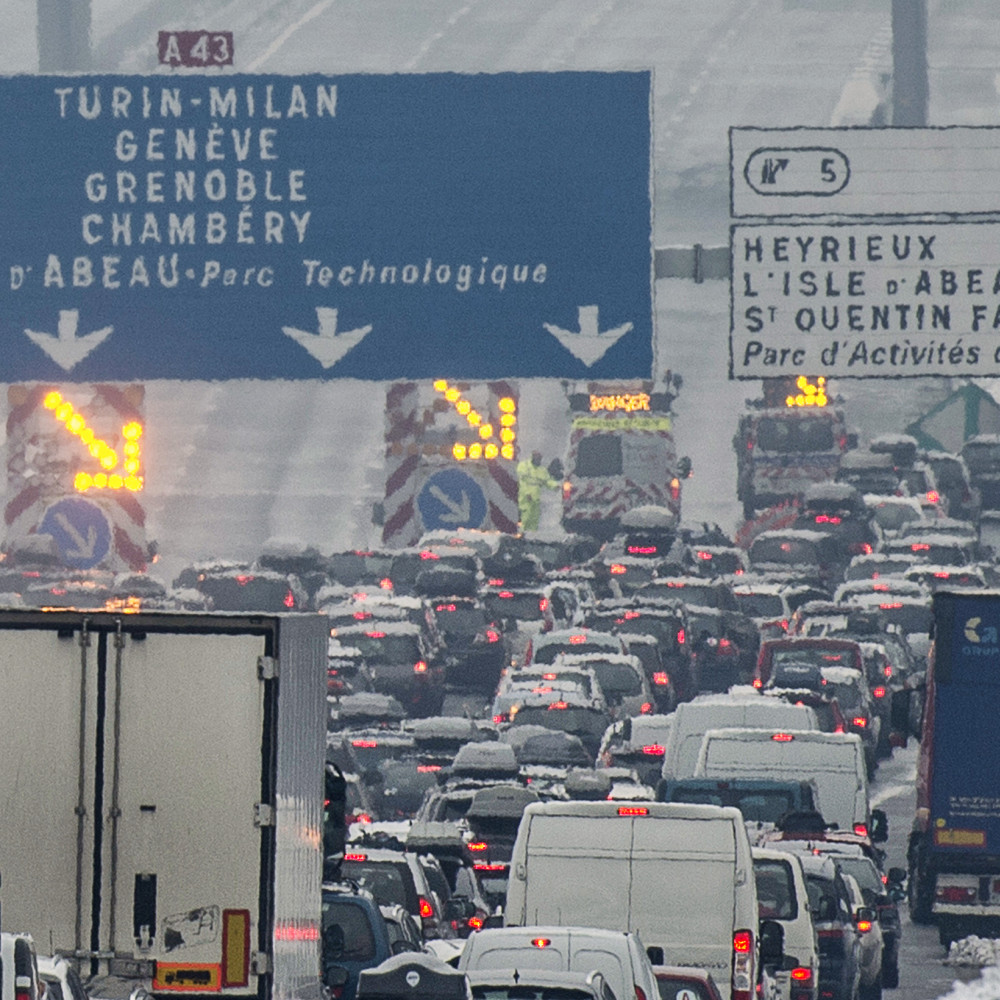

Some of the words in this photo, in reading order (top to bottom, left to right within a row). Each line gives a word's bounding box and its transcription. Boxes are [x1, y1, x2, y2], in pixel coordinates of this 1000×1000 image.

[163, 35, 181, 64] A
[190, 34, 230, 63] 43
[114, 122, 279, 162] GENÈVE
[84, 168, 308, 203] GRENOBLE
[819, 158, 838, 184] 5
[81, 205, 312, 246] CHAMBÉRY
[743, 234, 937, 263] HEYRIEUX
[302, 257, 549, 292] Technologique
[743, 271, 867, 297] L'ISLE
[794, 304, 952, 333] QUENTIN
[743, 340, 806, 367] Parc
[820, 338, 982, 367] d'Activités
